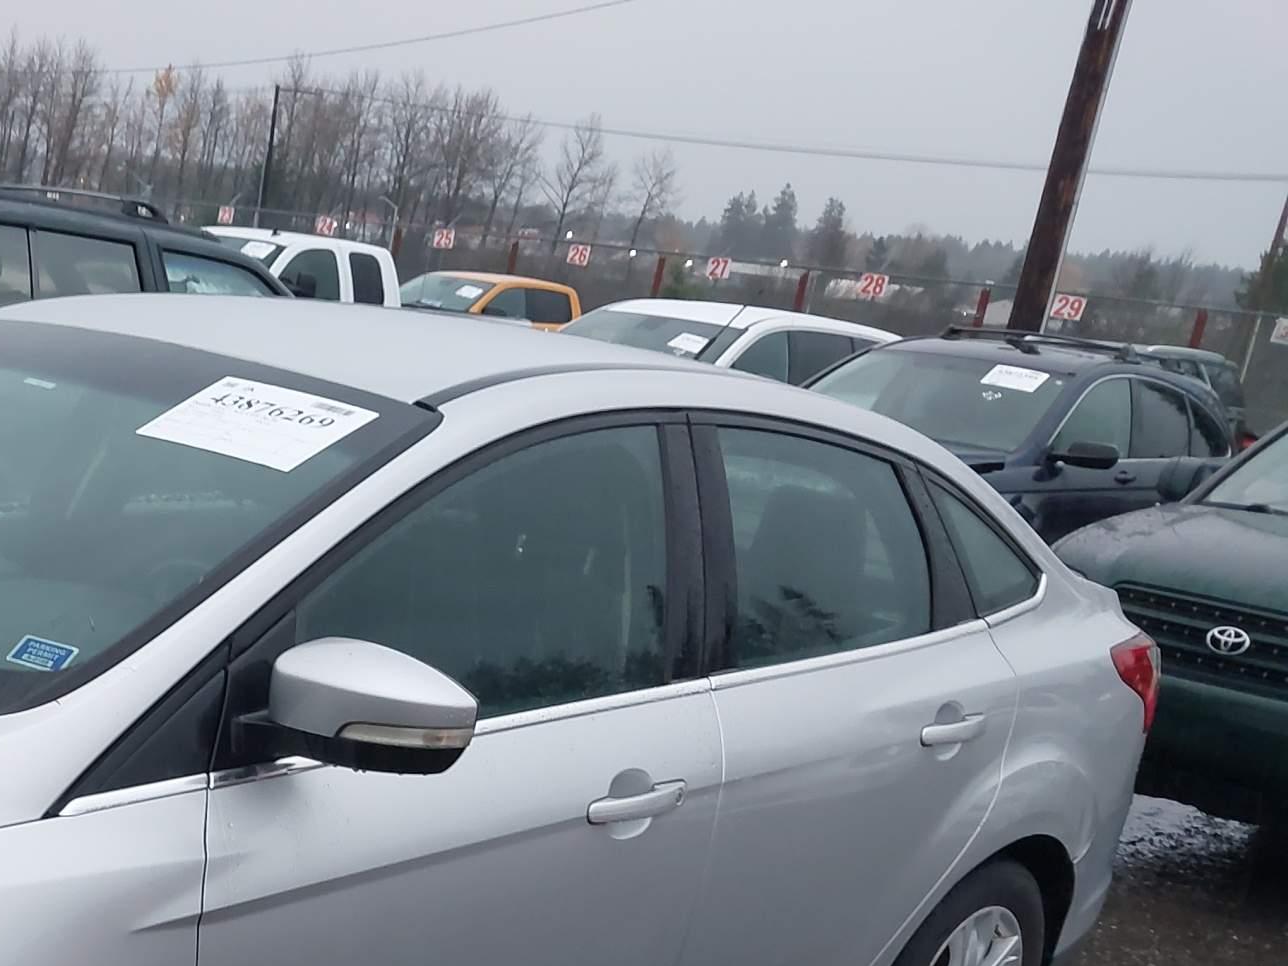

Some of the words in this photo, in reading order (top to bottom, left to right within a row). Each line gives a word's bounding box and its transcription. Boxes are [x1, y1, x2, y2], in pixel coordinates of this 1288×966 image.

[436, 229, 452, 248] 25
[569, 245, 588, 264] 26
[708, 258, 729, 279] 27
[861, 274, 886, 296] 28
[1053, 296, 1083, 320] 29
[210, 392, 335, 428] 43876269
